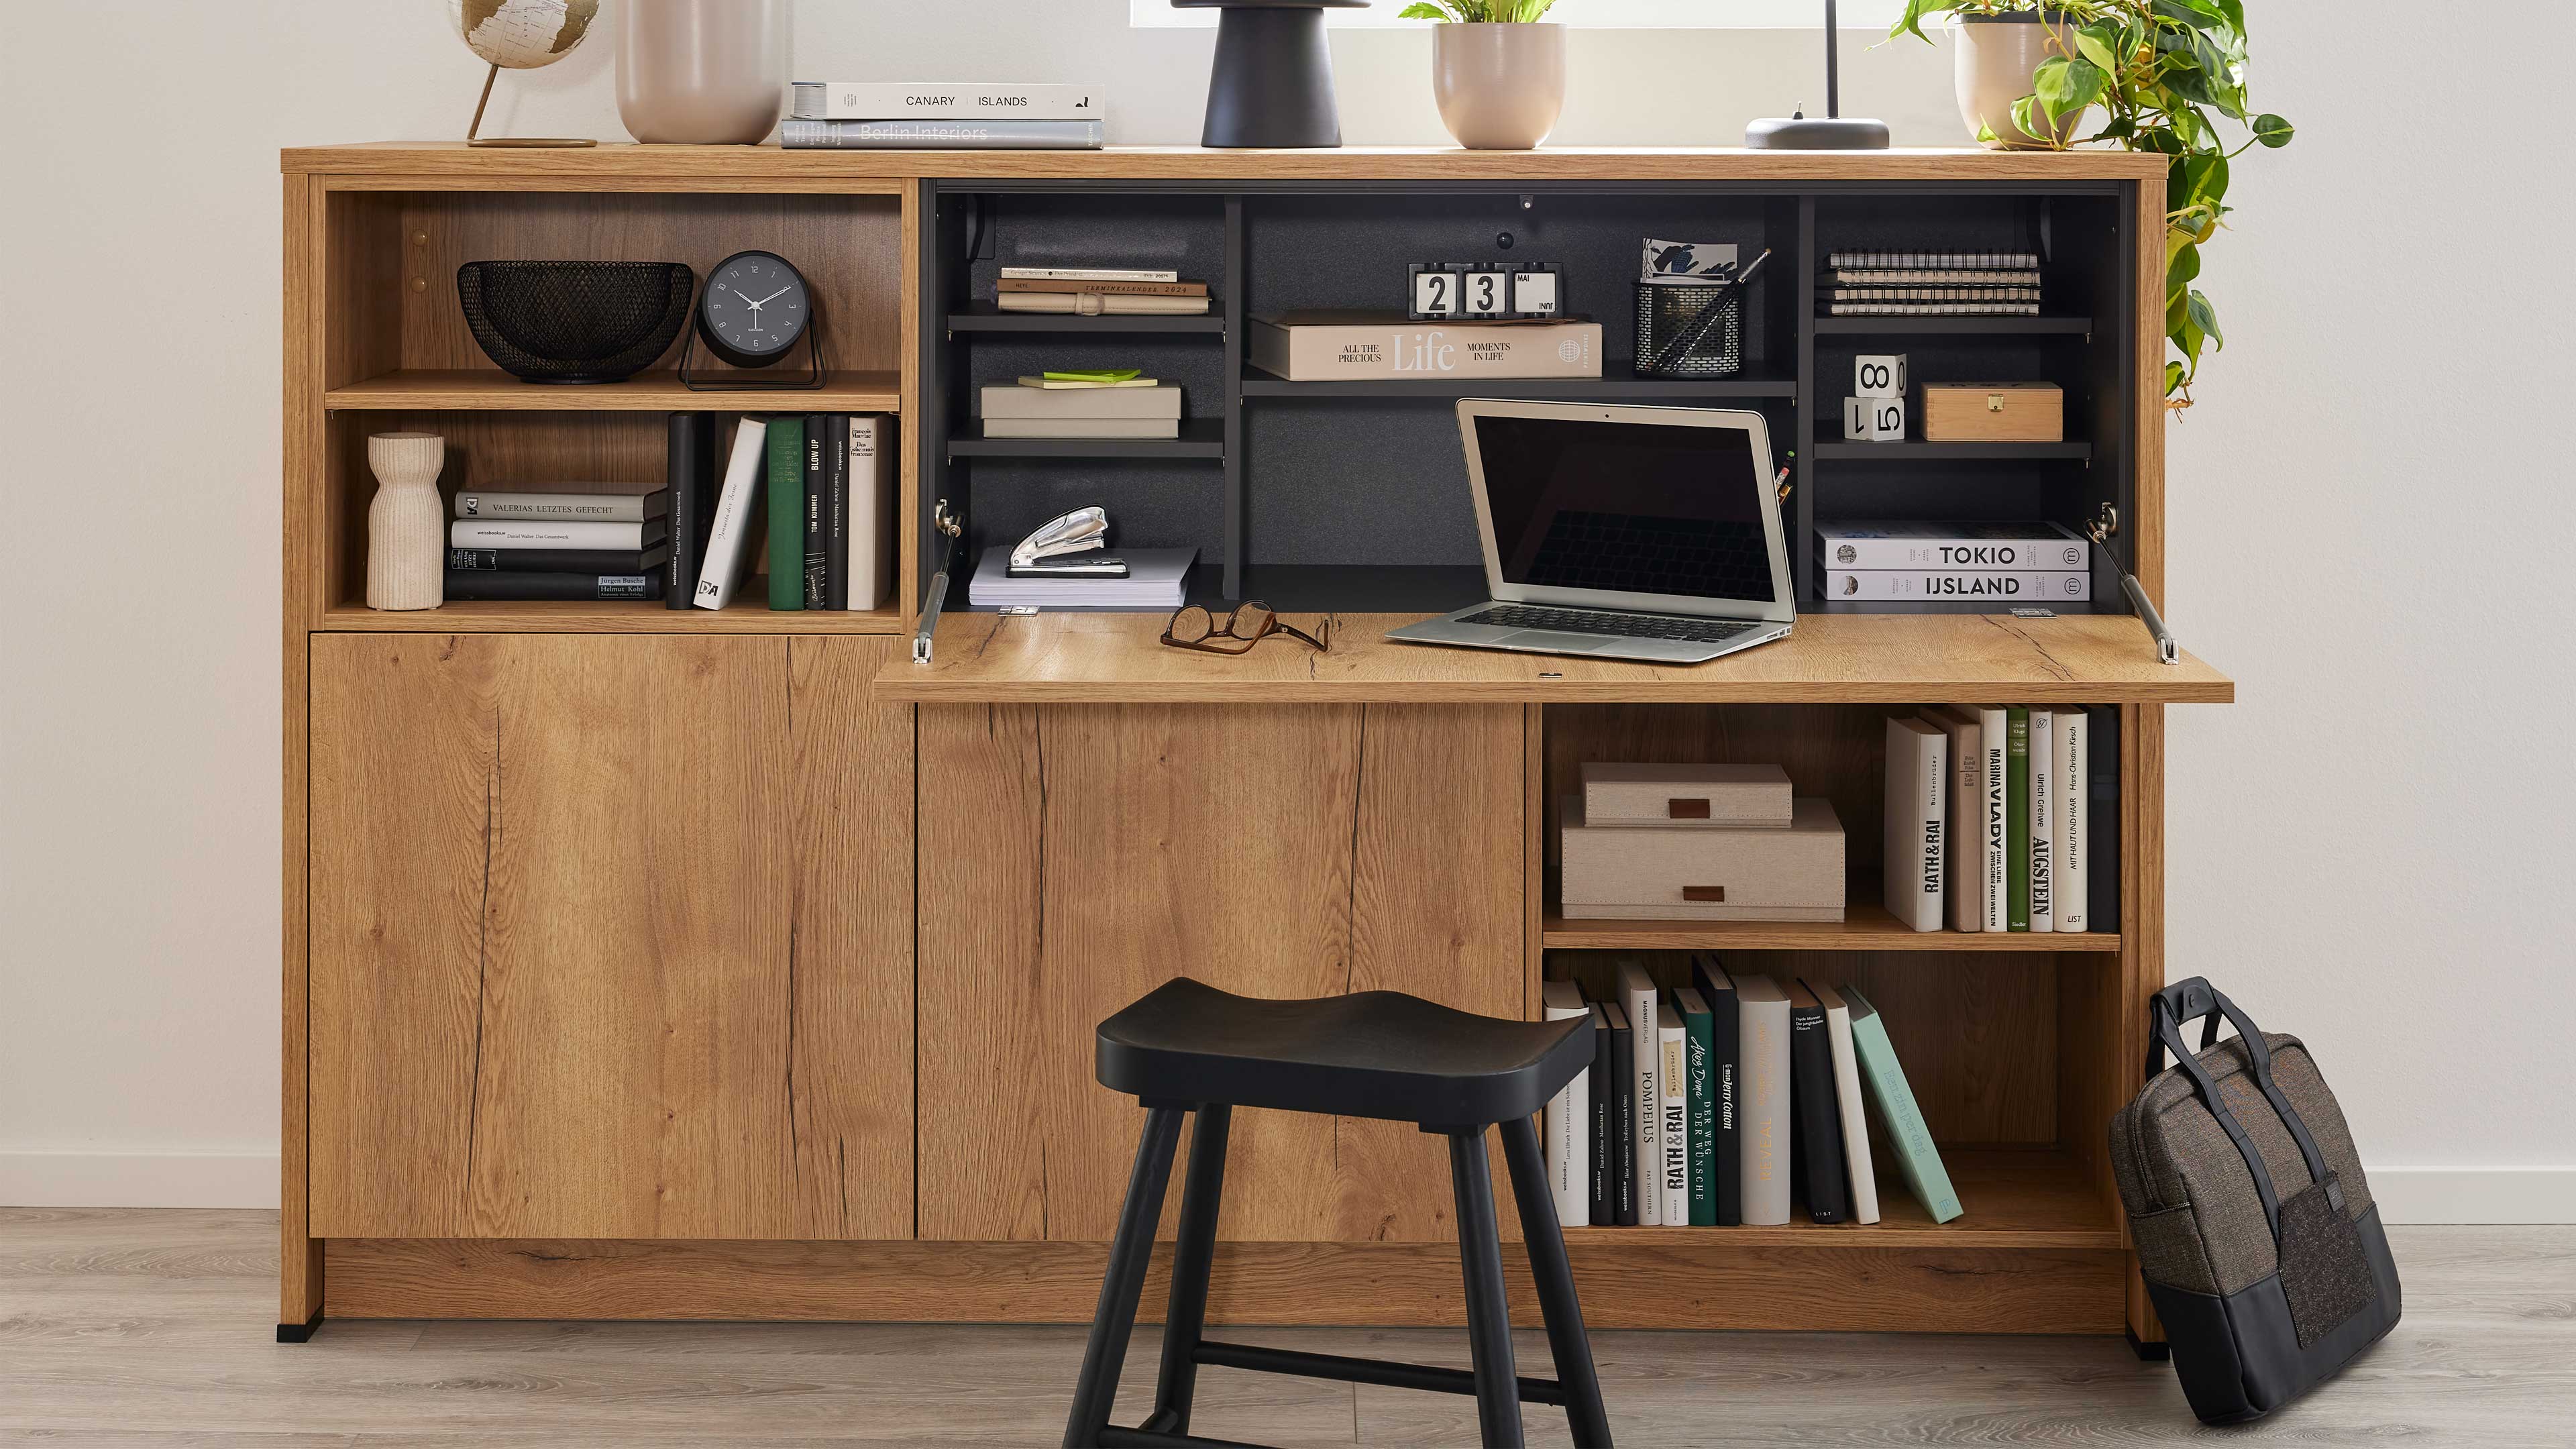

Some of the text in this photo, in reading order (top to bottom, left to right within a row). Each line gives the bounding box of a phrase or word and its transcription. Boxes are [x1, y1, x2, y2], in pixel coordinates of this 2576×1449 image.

[906, 97, 1026, 106] CANARY ISLANDS
[859, 123, 912, 142] Berlin
[914, 125, 989, 142] Interiors
[731, 270, 739, 278] 11
[1085, 284, 1158, 292] TERMINKALENDER
[1429, 276, 1446, 311] 2
[1477, 275, 1493, 311] 3
[735, 334, 741, 342] 7
[1342, 343, 1379, 353] ALL THE
[1392, 330, 1457, 370] Life
[1339, 354, 1381, 362] PRECIOUS
[1861, 364, 1889, 389] 8
[812, 439, 818, 448] UP
[492, 504, 613, 515] VALERIAS LETZTES GEFECHT
[1939, 547, 2015, 564] TOKIO
[1927, 578, 2019, 594] IJSLAND
[1989, 748, 2002, 850] MARINA VLADY
[2033, 837, 2050, 916] AUGSTEIN
[1642, 1072, 1653, 1143] POMPEIUS
[1723, 1102, 1733, 1130] Cotton
[1760, 1117, 1773, 1182] REVEAL
[1696, 1142, 1704, 1199] WÜNSCHE
